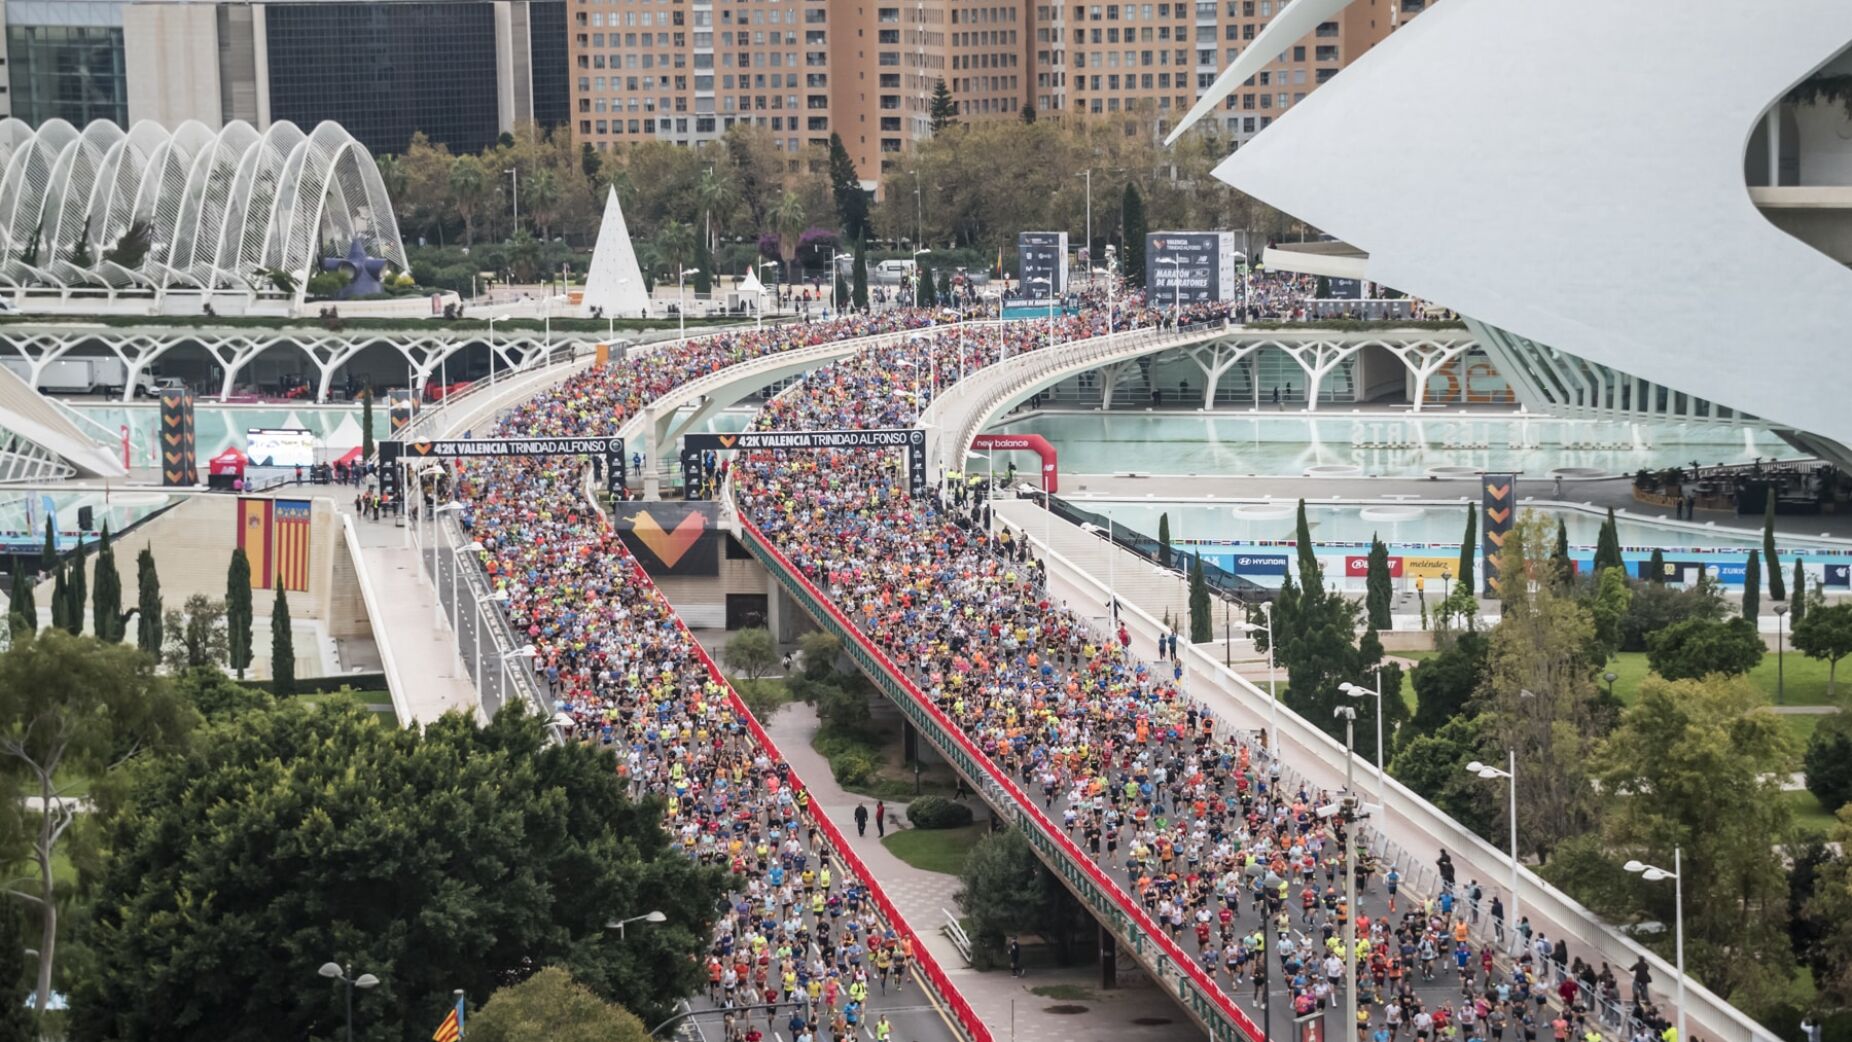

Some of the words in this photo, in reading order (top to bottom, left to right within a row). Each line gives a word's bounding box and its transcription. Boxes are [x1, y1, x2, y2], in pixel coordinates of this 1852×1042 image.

[1166, 279, 1208, 287] MARATONES
[738, 435, 760, 447] 42K
[760, 434, 811, 447] VALENCIA
[811, 433, 858, 445] TRINIDAD
[858, 432, 907, 444] ALFONSO
[994, 439, 1029, 447] balance
[433, 443, 457, 455] 42K
[457, 442, 508, 454] VALENCIA
[508, 441, 557, 453] TRINIDAD
[557, 440, 606, 453] ALFONSO
[1409, 559, 1449, 569] meléndez
